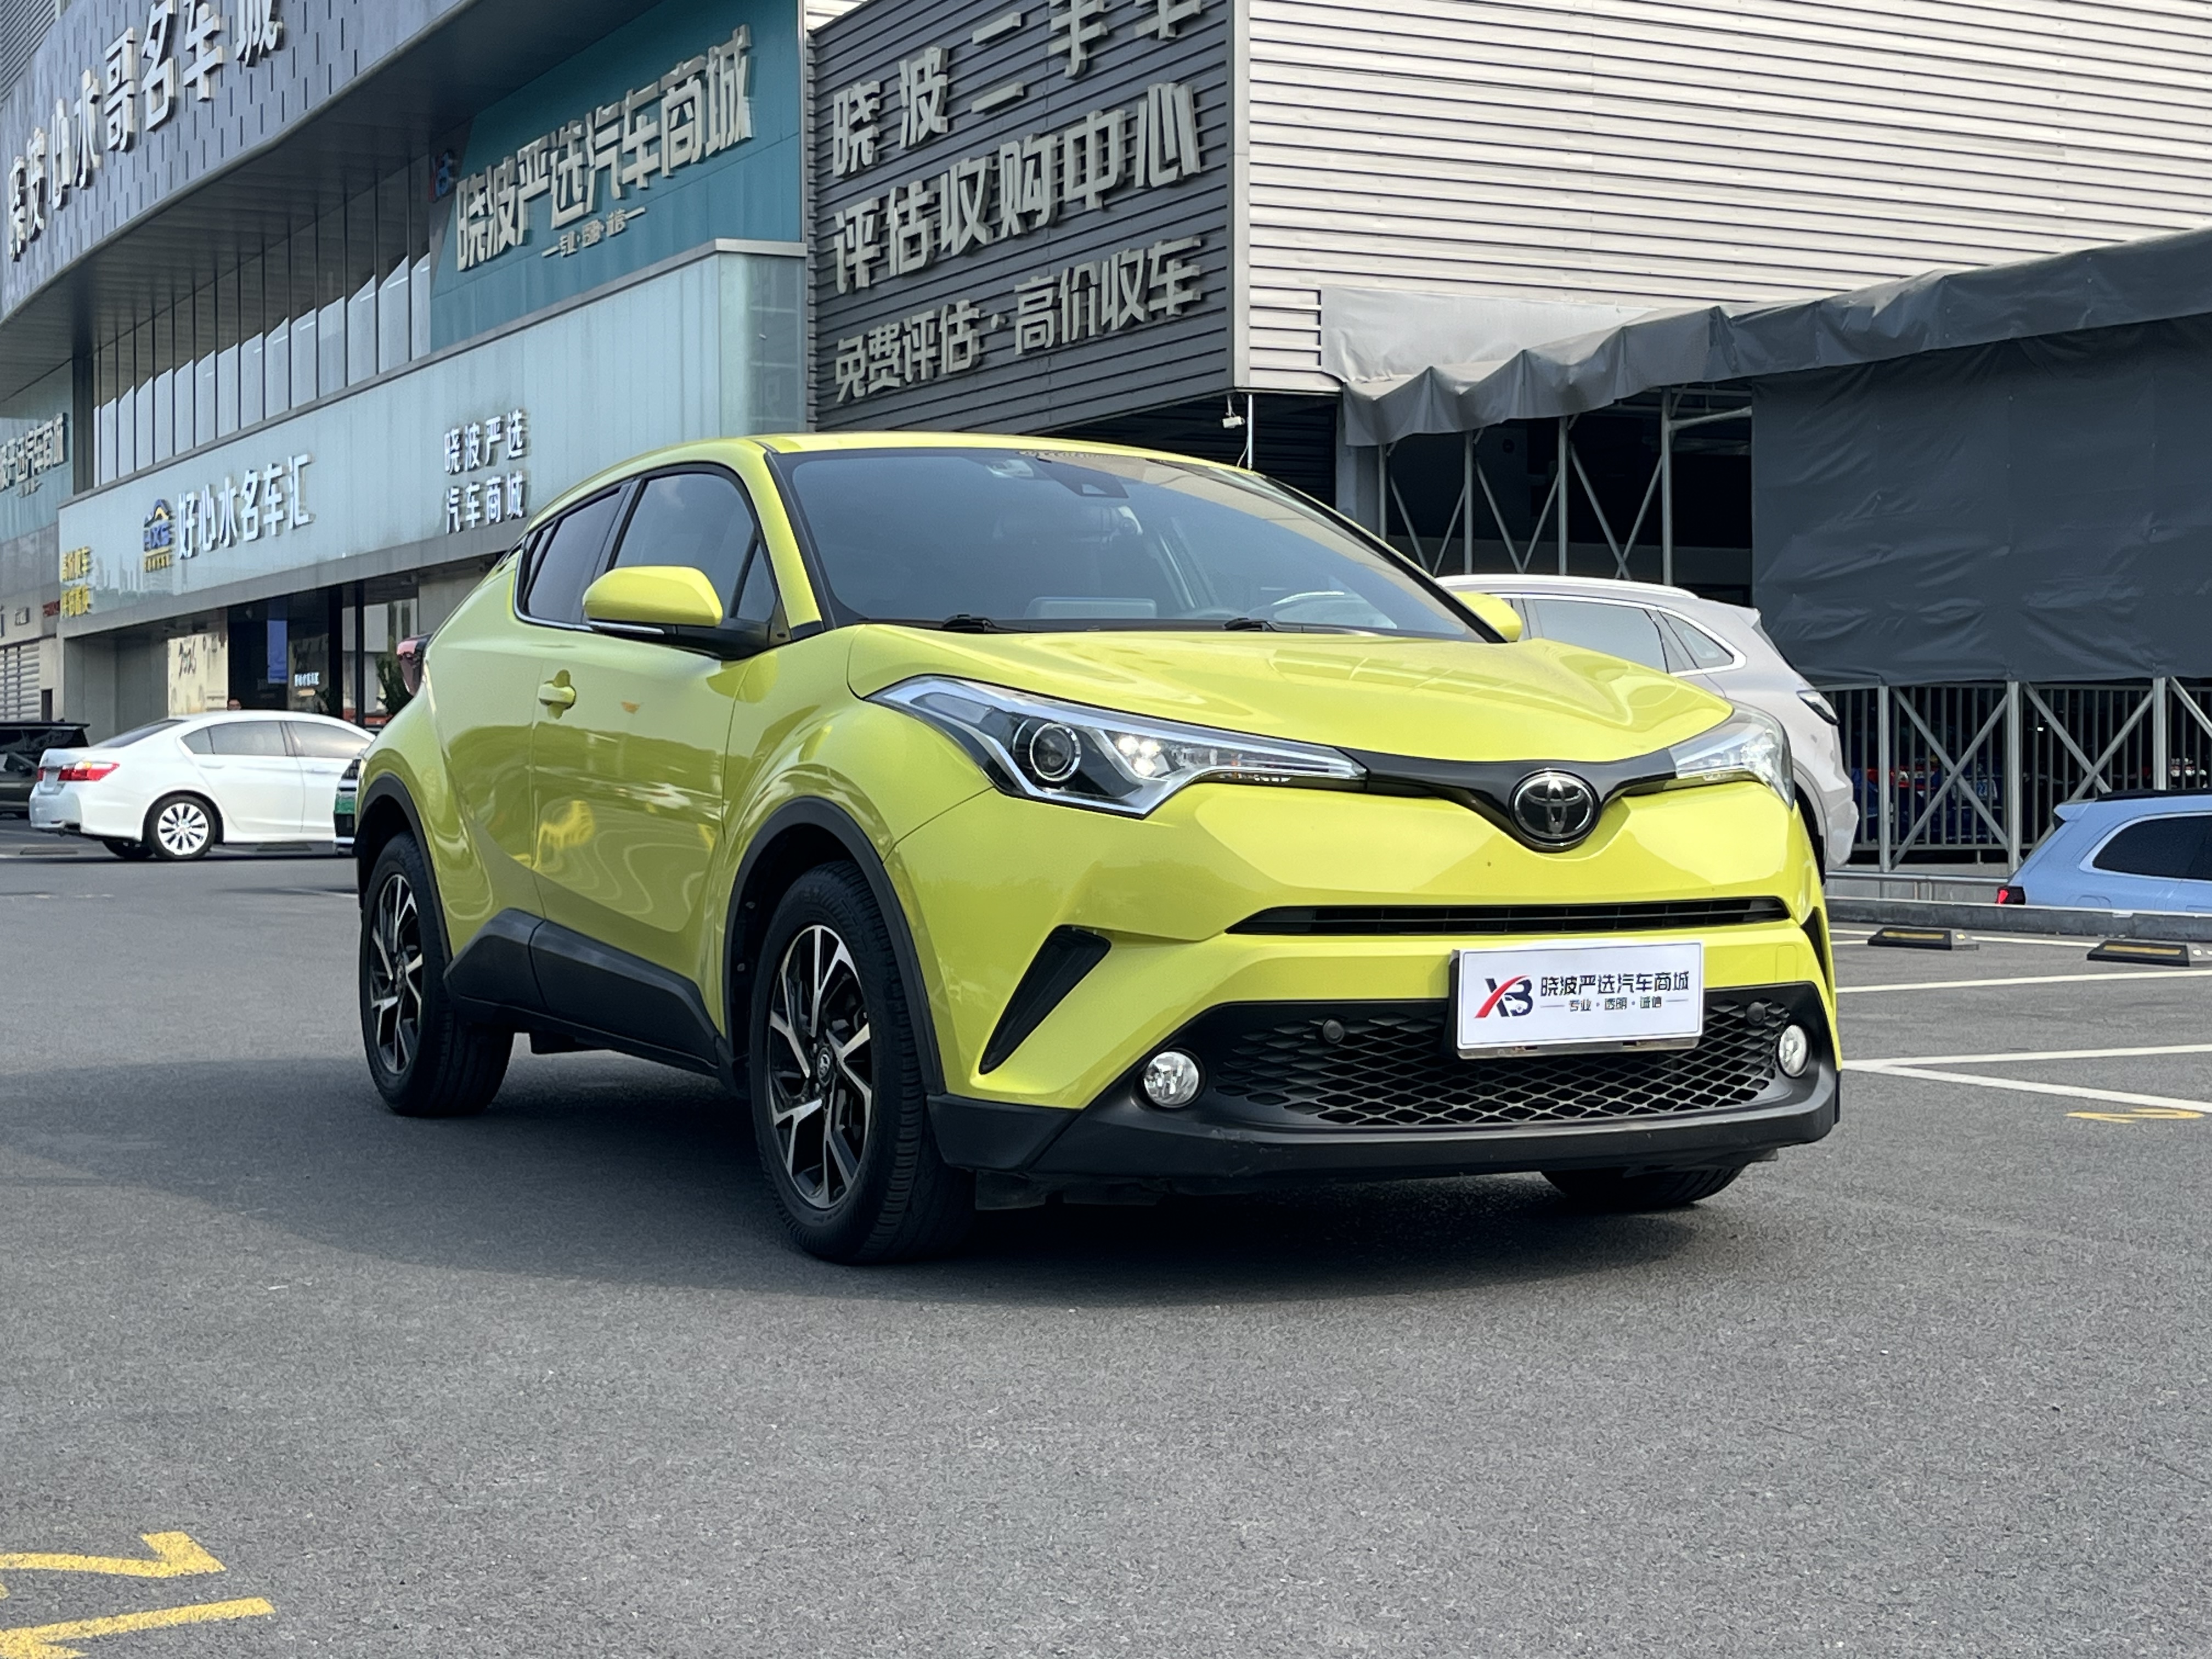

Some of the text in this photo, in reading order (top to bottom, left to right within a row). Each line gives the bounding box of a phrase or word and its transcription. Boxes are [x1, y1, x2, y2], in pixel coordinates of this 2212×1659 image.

[456, 24, 752, 271] 晓波严选汽车商城
[833, 83, 1201, 295] 评估收购中心
[444, 409, 527, 474] 晓波严选
[178, 454, 311, 559] 好心水名车汇
[445, 471, 527, 534] 汽车商城
[1540, 970, 1689, 997] 晓波严选汽车商城
